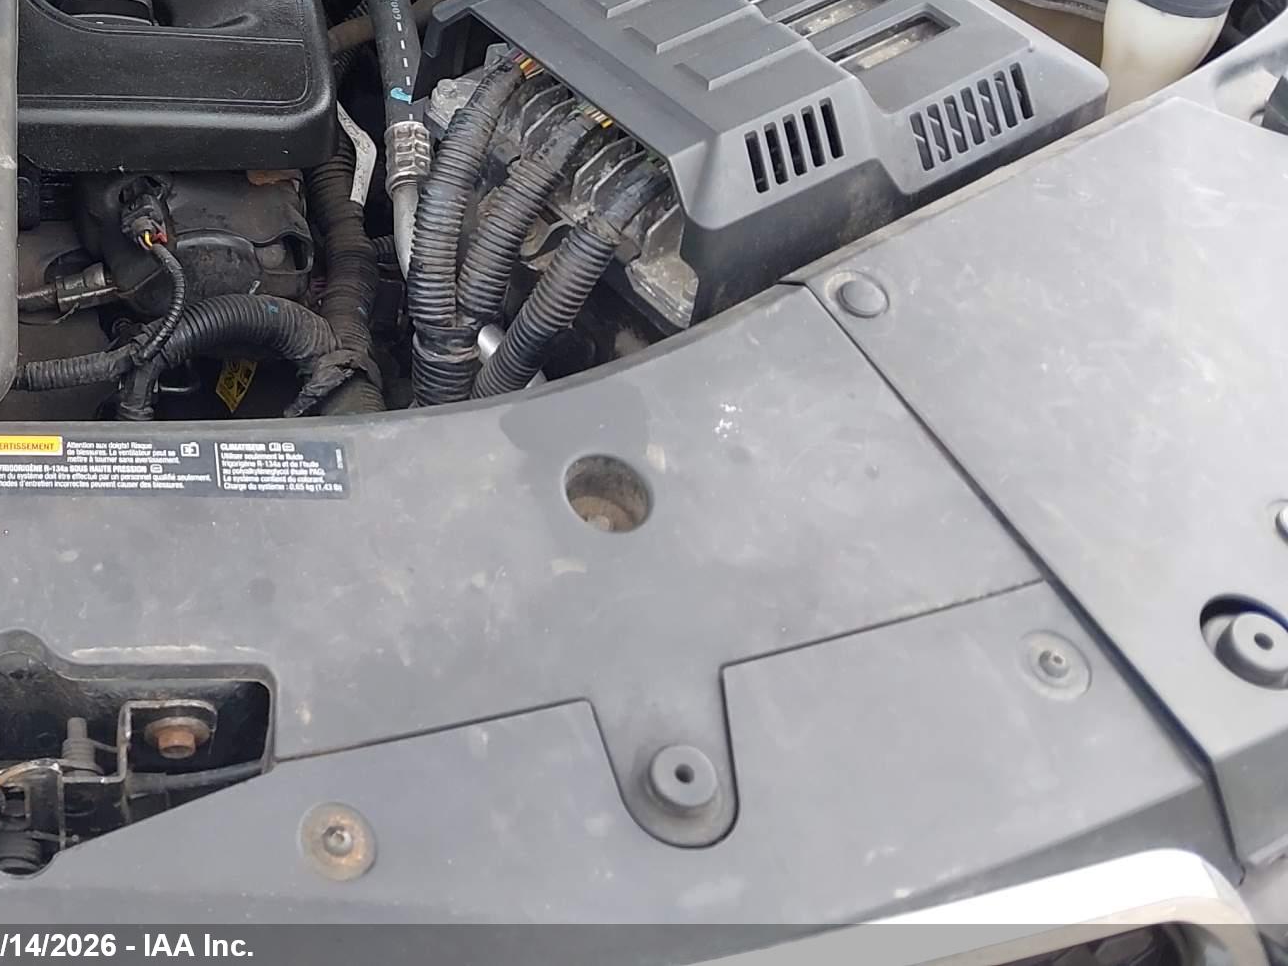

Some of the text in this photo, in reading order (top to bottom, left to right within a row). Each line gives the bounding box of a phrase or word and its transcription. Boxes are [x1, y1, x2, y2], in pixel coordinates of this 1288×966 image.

[44, 464, 68, 472] R-134a
[69, 465, 88, 473] SOUS
[89, 465, 112, 473] HAUTE
[113, 465, 147, 473] PRESSION
[99, 473, 110, 481] par
[120, 473, 151, 481] personnel
[54, 480, 89, 488] incorrectes
